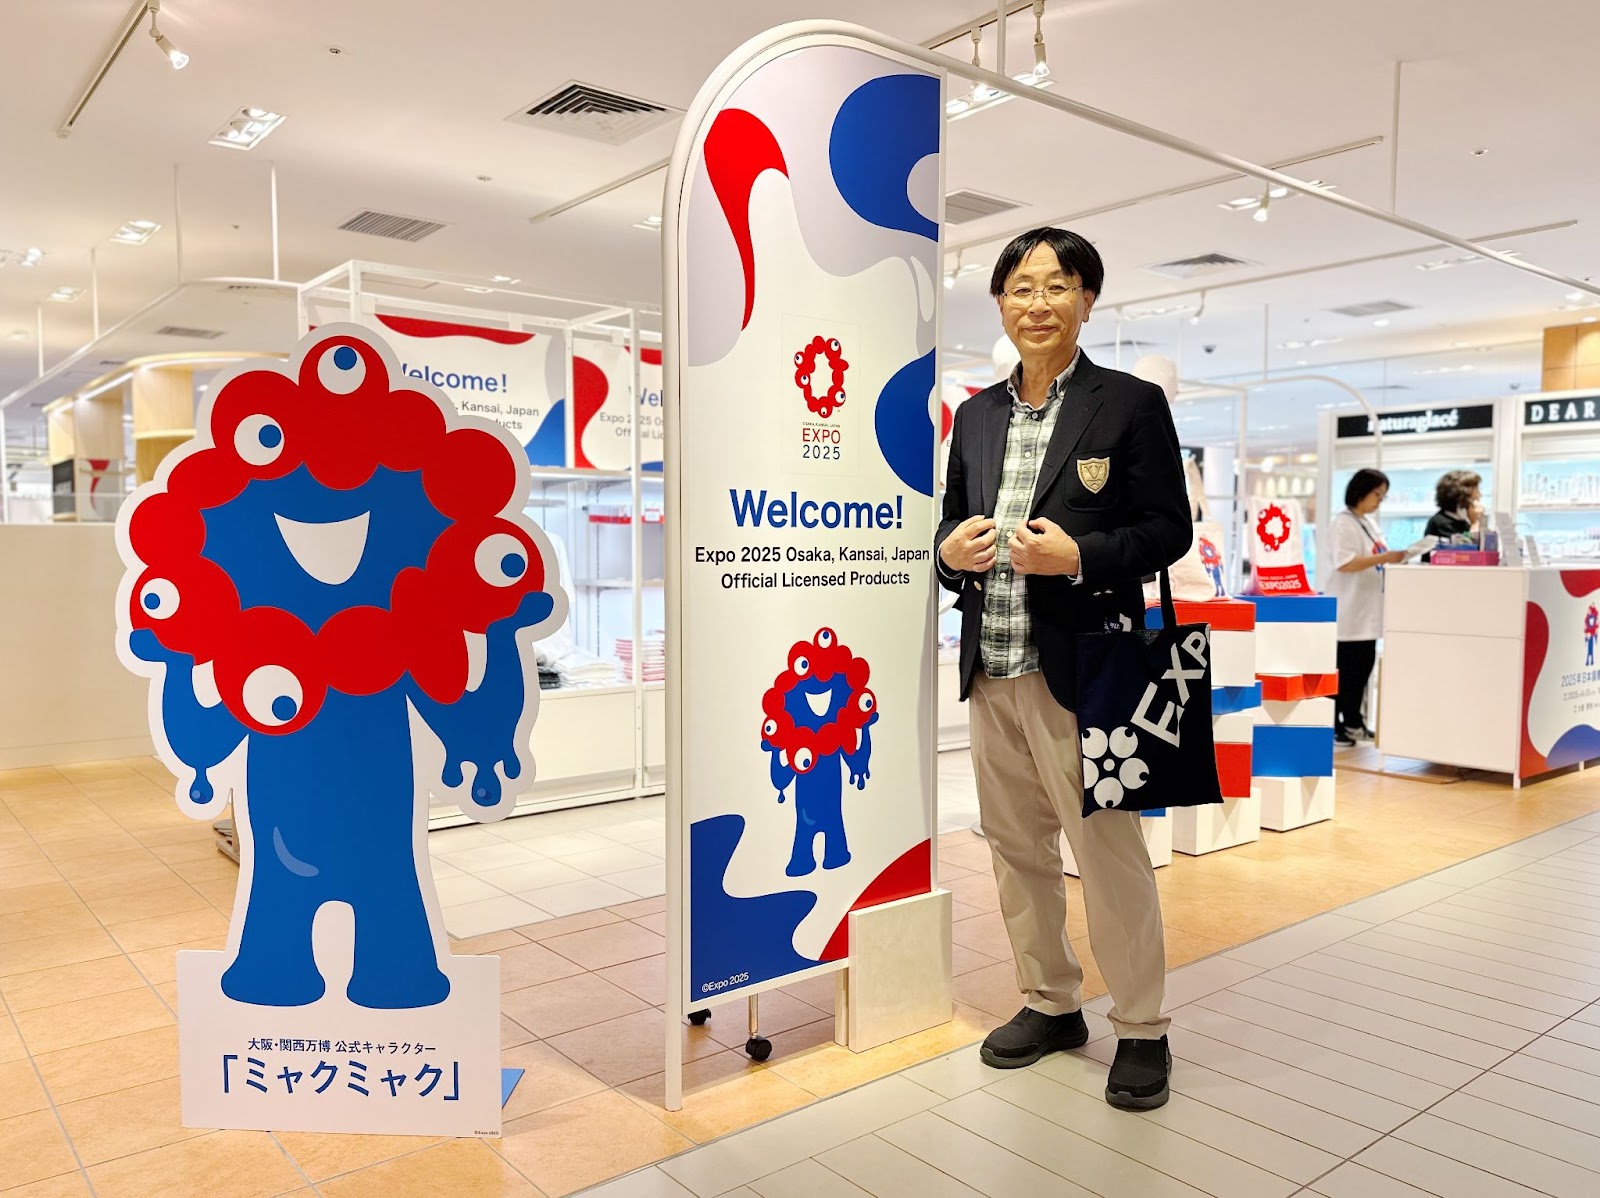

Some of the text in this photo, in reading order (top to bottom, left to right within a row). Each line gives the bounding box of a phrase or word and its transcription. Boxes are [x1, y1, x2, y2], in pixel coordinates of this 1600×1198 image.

[506, 405, 539, 417] Japan
[600, 412, 625, 424] Expo
[627, 414, 651, 426] 225
[1531, 401, 1595, 422] DEAR
[802, 428, 841, 444] EXPO
[802, 444, 841, 460] 2025
[729, 488, 903, 530] Welcome!
[695, 546, 930, 566] Expo 2025 Osaka, Kansai, Japan
[721, 570, 910, 589] Official Licensed Products
[1130, 623, 1211, 748] EXP
[729, 971, 750, 985] 2025
[248, 1037, 436, 1056] 大阪・関西万博 公式キャラクター
[222, 1054, 459, 1101] 「ミャクミャク」
